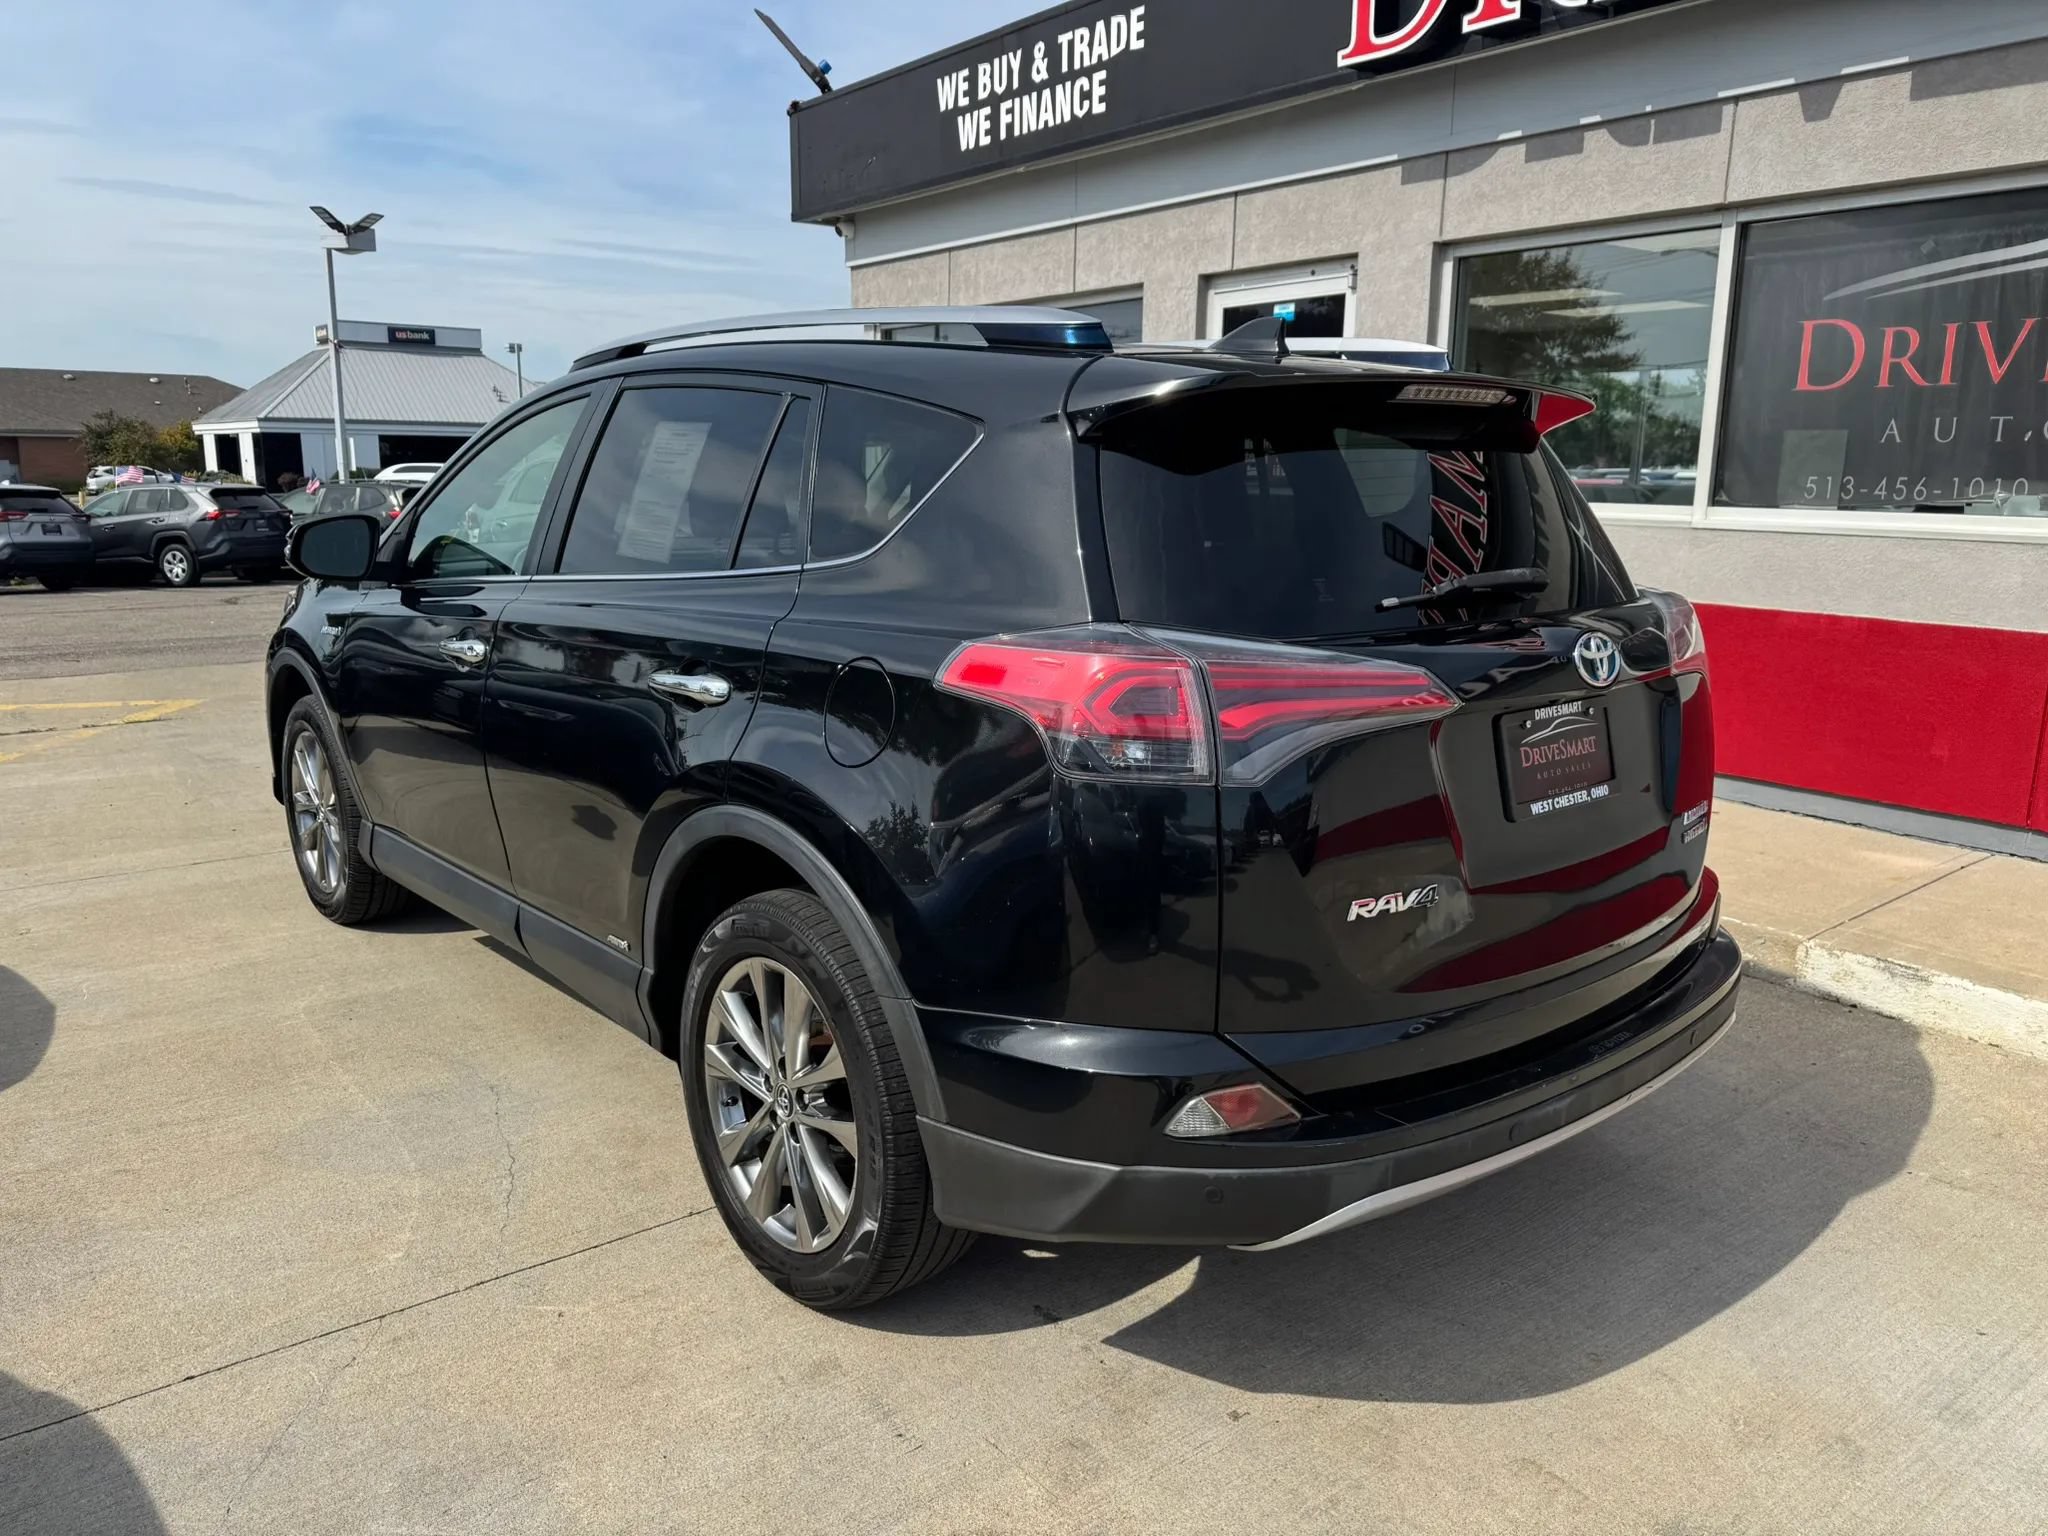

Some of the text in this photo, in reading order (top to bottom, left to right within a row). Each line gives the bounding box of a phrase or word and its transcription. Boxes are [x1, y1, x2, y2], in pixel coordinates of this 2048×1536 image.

[937, 5, 1145, 112] WE BUY & TRADE
[957, 69, 1107, 151] WE FINANCE
[1792, 317, 2048, 391] DRIV
[1880, 415, 2048, 443] AUT
[1804, 475, 2029, 501] 513-456-1010
[1534, 701, 1582, 720] DRIVESMART
[1530, 798, 1553, 815] WEST
[1553, 789, 1591, 809] CHESTER,
[1590, 784, 1609, 799] OHIO
[1346, 883, 1439, 922] RAV4
